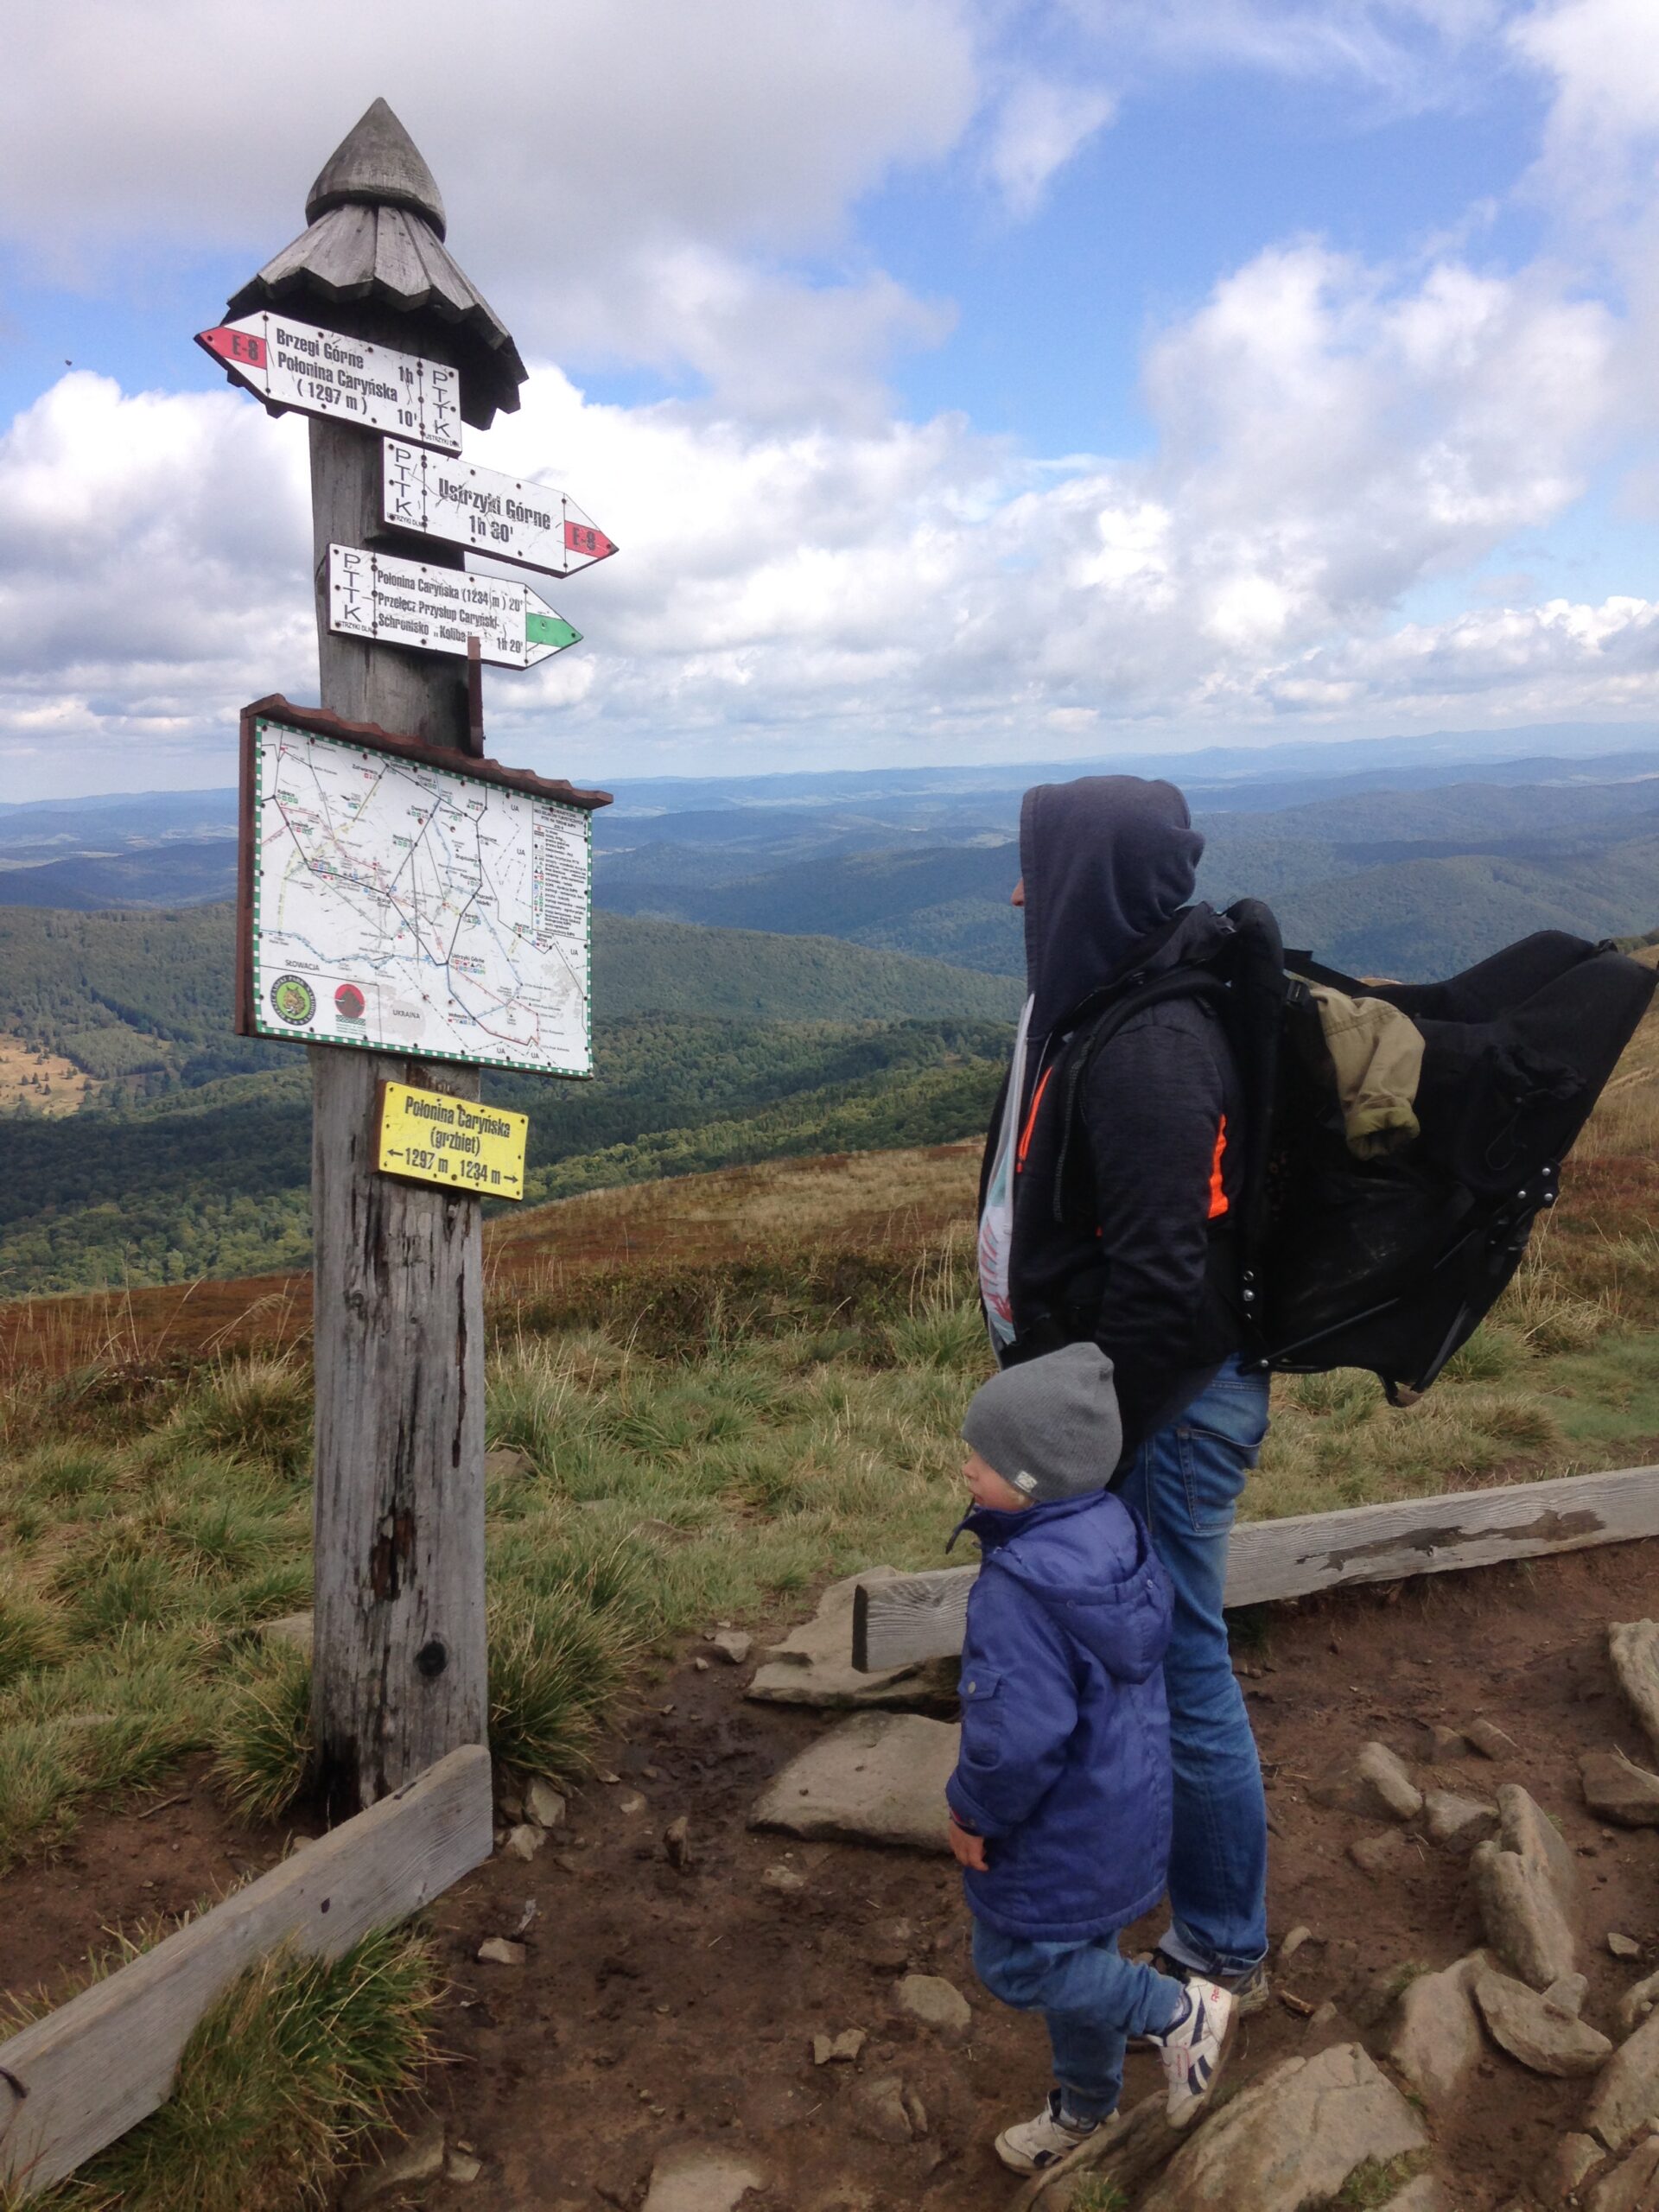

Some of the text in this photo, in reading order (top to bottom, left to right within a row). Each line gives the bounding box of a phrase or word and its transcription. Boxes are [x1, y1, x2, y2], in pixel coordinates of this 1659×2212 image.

[232, 334, 258, 361] E-8
[276, 327, 364, 369] Brzegi Górne
[278, 351, 397, 402] Połonina Caryńska
[398, 366, 413, 385] 1h
[397, 409, 416, 427] 10'
[439, 478, 550, 530] Ustrzyki Górne
[469, 515, 486, 536] 1h
[378, 570, 416, 590] Połonina
[418, 578, 460, 600] Caryńska
[378, 592, 416, 613] Przełęcz
[419, 601, 457, 622] Przysłup
[378, 613, 429, 636] Schronisko
[285, 959, 320, 971] SŁOWACJA
[392, 1009, 420, 1019] UKRAINA
[404, 1096, 511, 1138] Połonina Caryńska
[430, 1127, 480, 1156] (grzbiet)
[405, 1147, 501, 1185] 1297 m 1234 m
